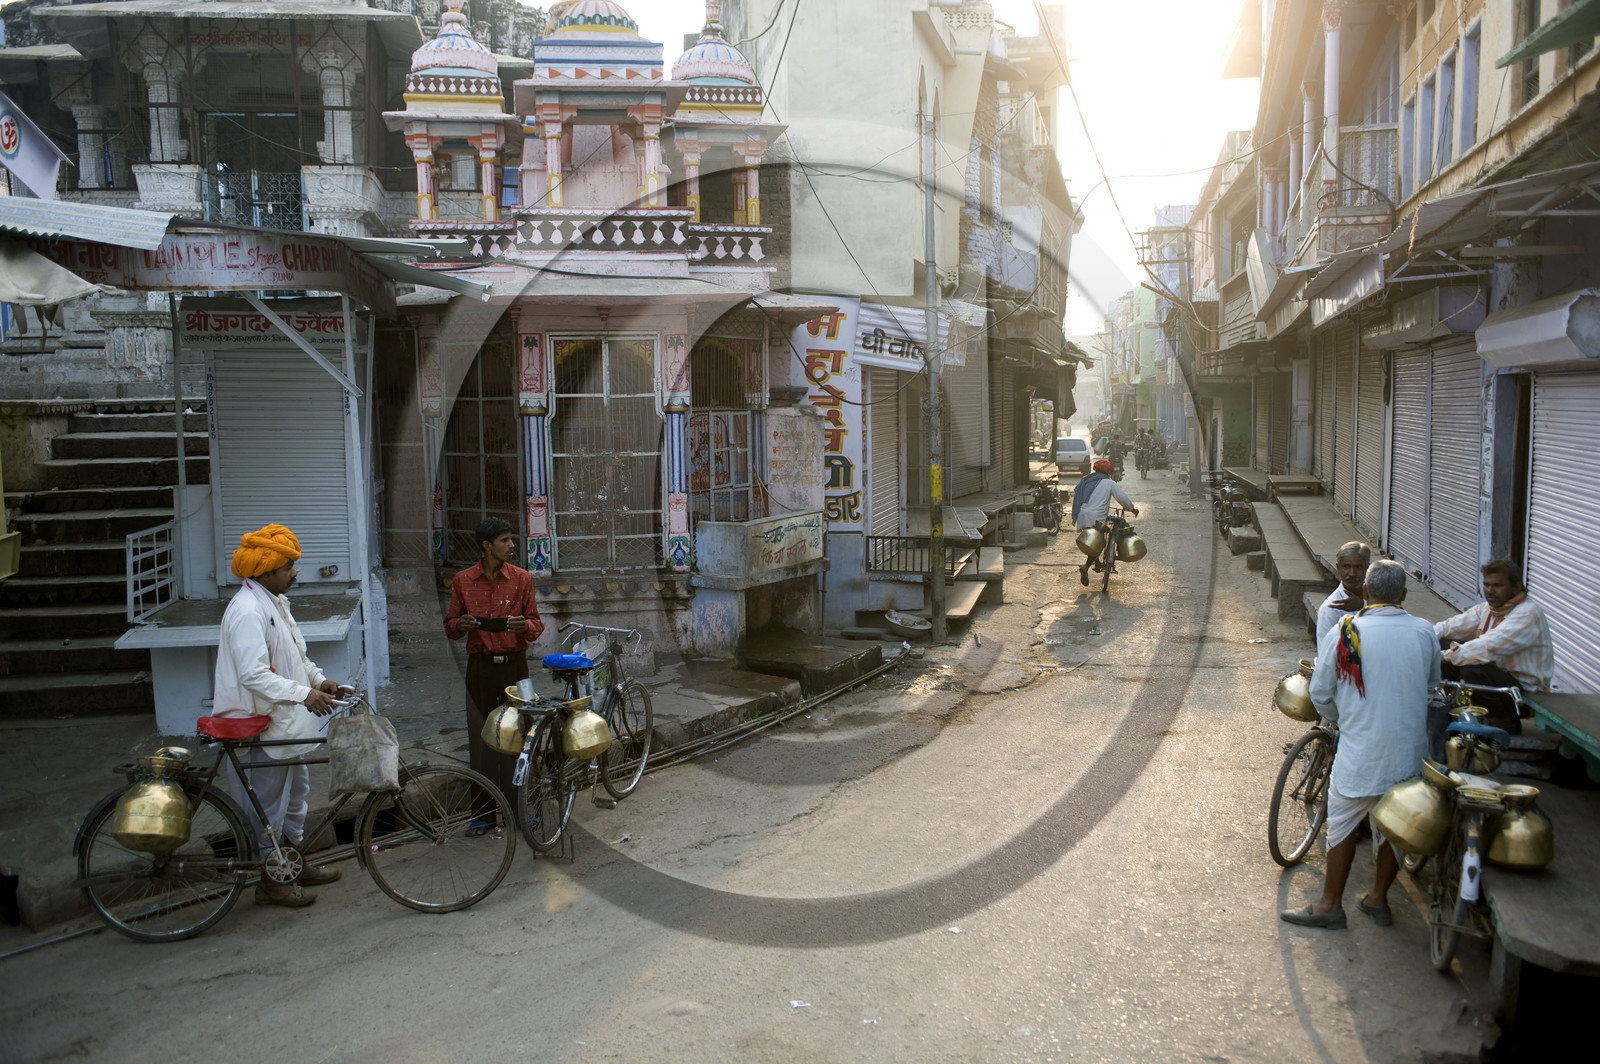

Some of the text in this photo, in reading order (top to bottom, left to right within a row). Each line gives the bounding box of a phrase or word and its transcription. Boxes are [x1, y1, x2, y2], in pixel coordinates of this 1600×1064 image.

[248, 245, 281, 267] Shree
[184, 309, 210, 332] श्री
[824, 490, 862, 523] डार
